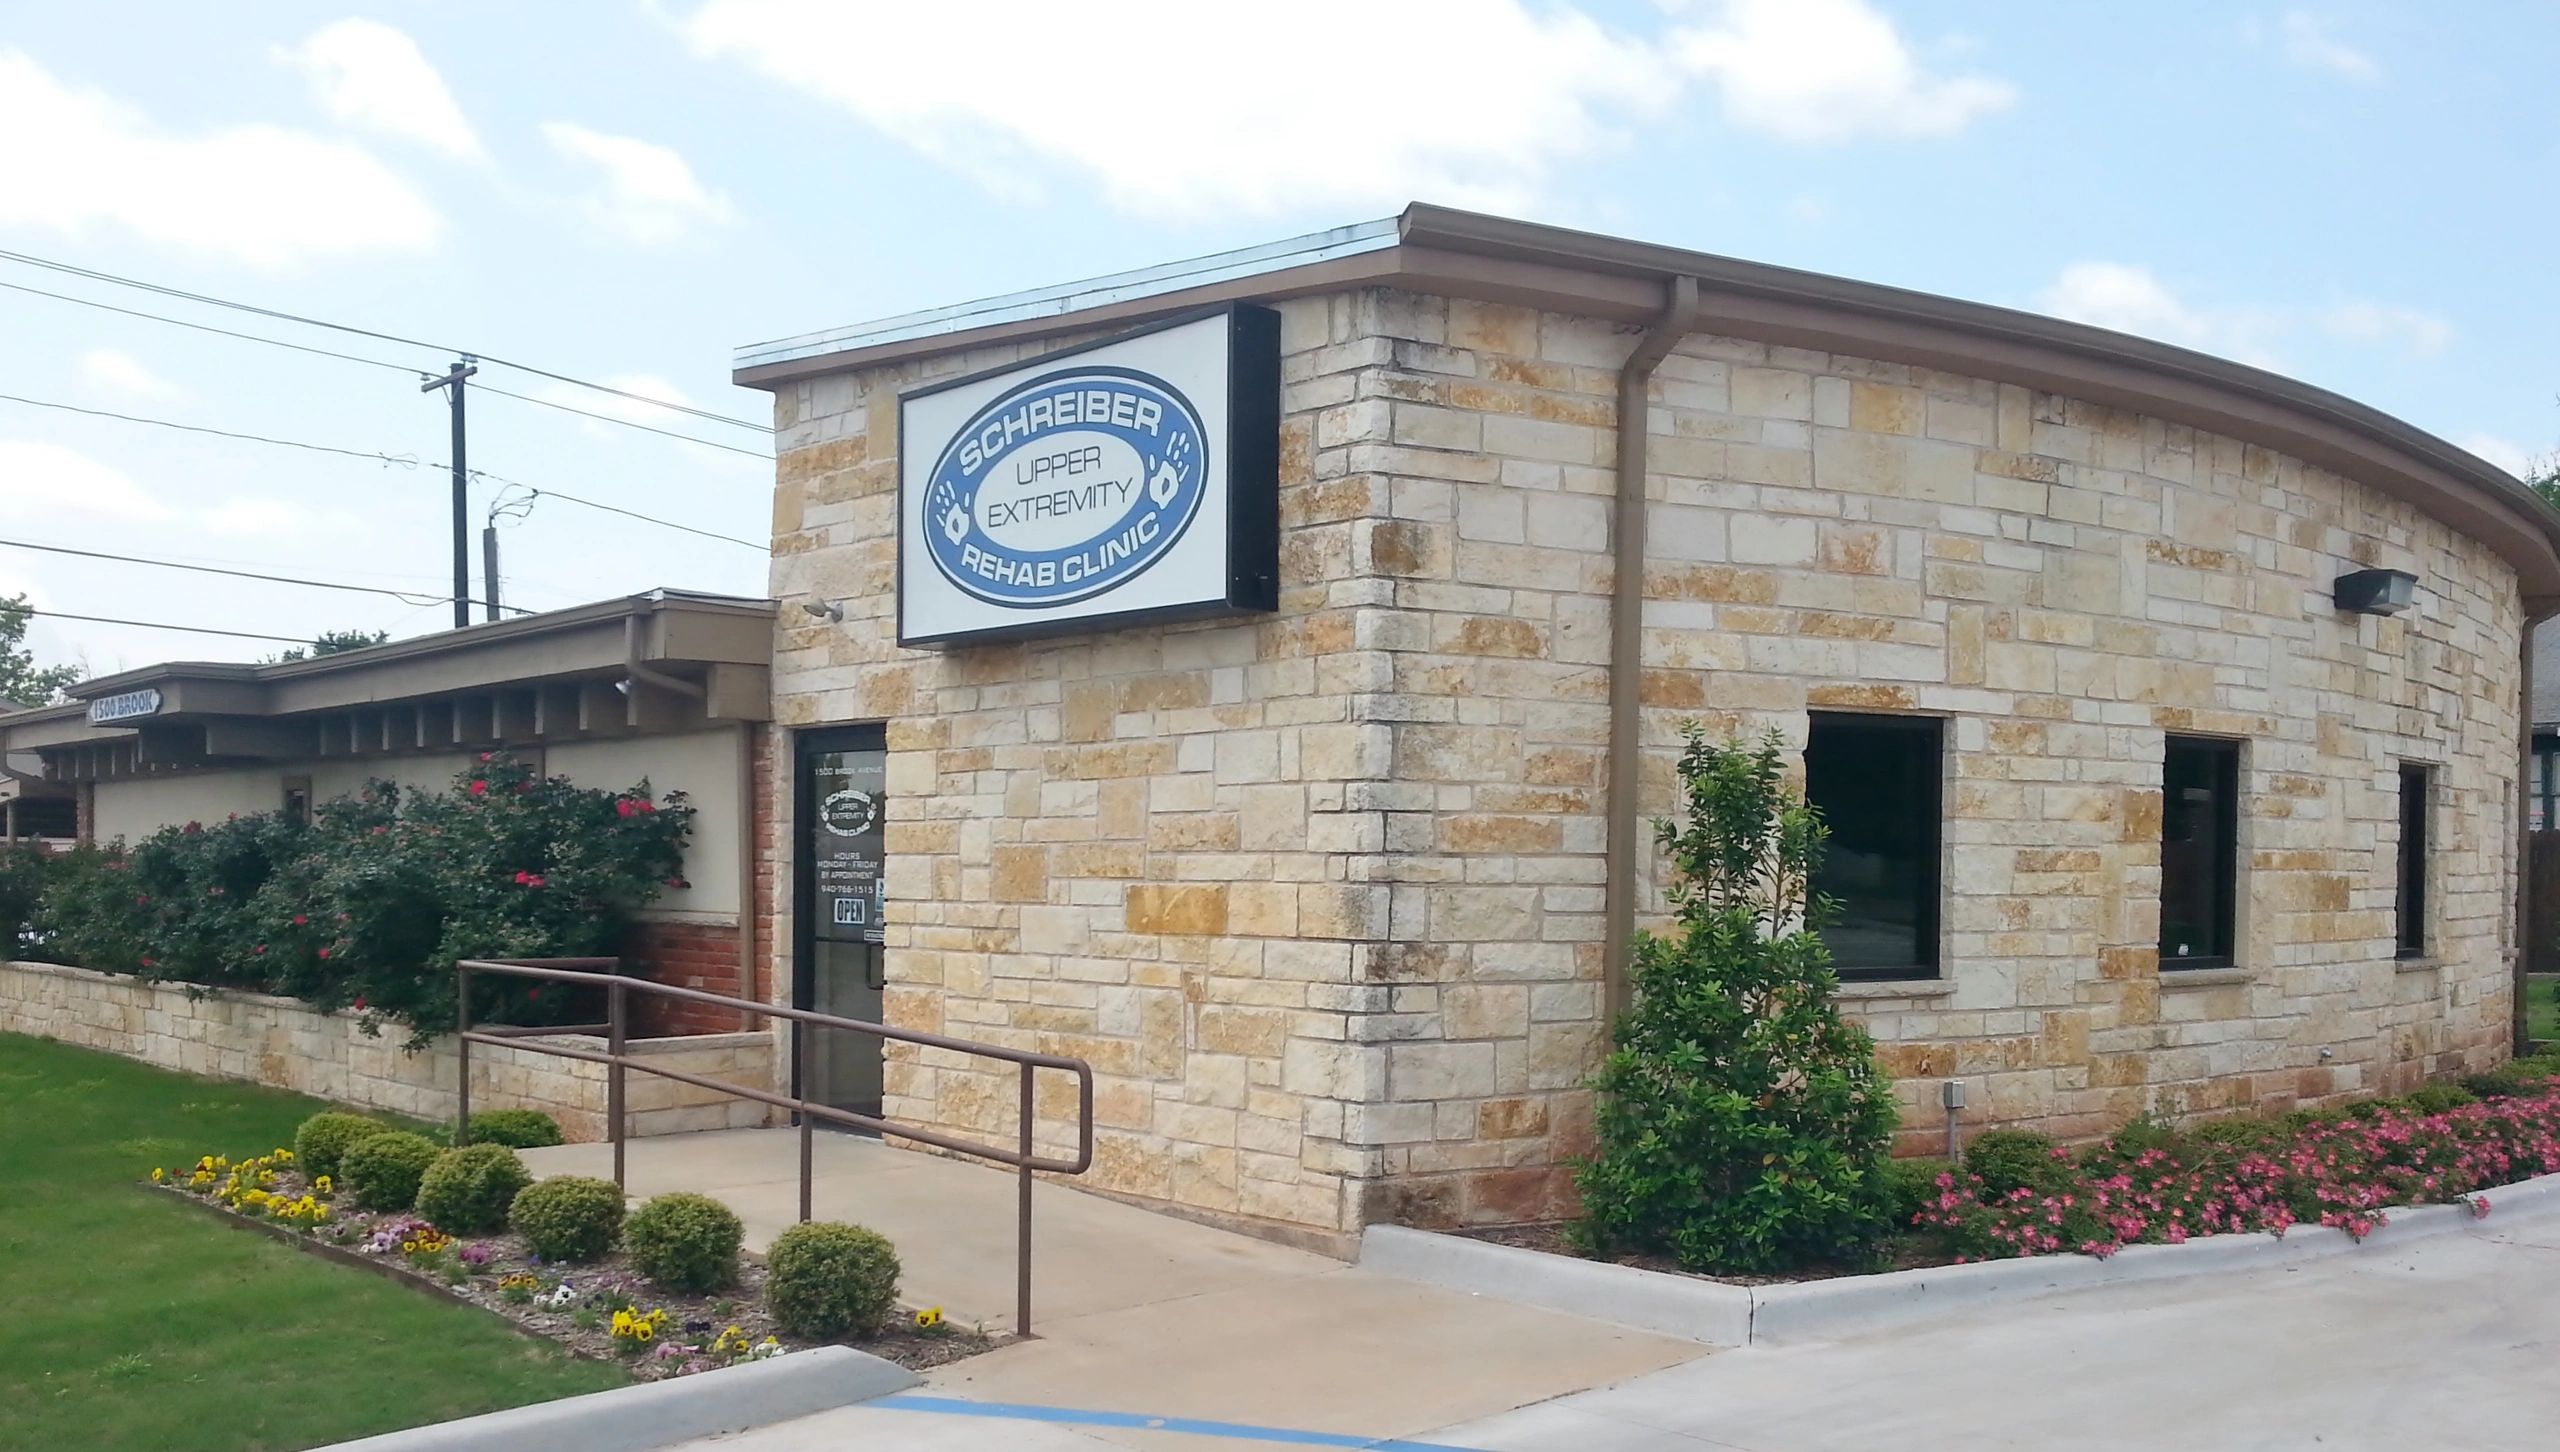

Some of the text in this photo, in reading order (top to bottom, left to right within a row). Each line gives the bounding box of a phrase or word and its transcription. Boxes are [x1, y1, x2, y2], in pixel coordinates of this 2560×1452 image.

[959, 390, 1163, 477] SCHREIBER
[1016, 446, 1101, 486] UPPER
[988, 477, 1134, 528] EXTREMITY
[960, 511, 1161, 588] REHAB CLINIC
[95, 691, 153, 719] 1500 BROOK
[815, 768, 833, 776] 1500
[838, 803, 858, 811] UPPER
[834, 852, 860, 860] HOURS
[821, 871, 874, 879] BY APPOINTMENT
[837, 899, 863, 922] OPEN
